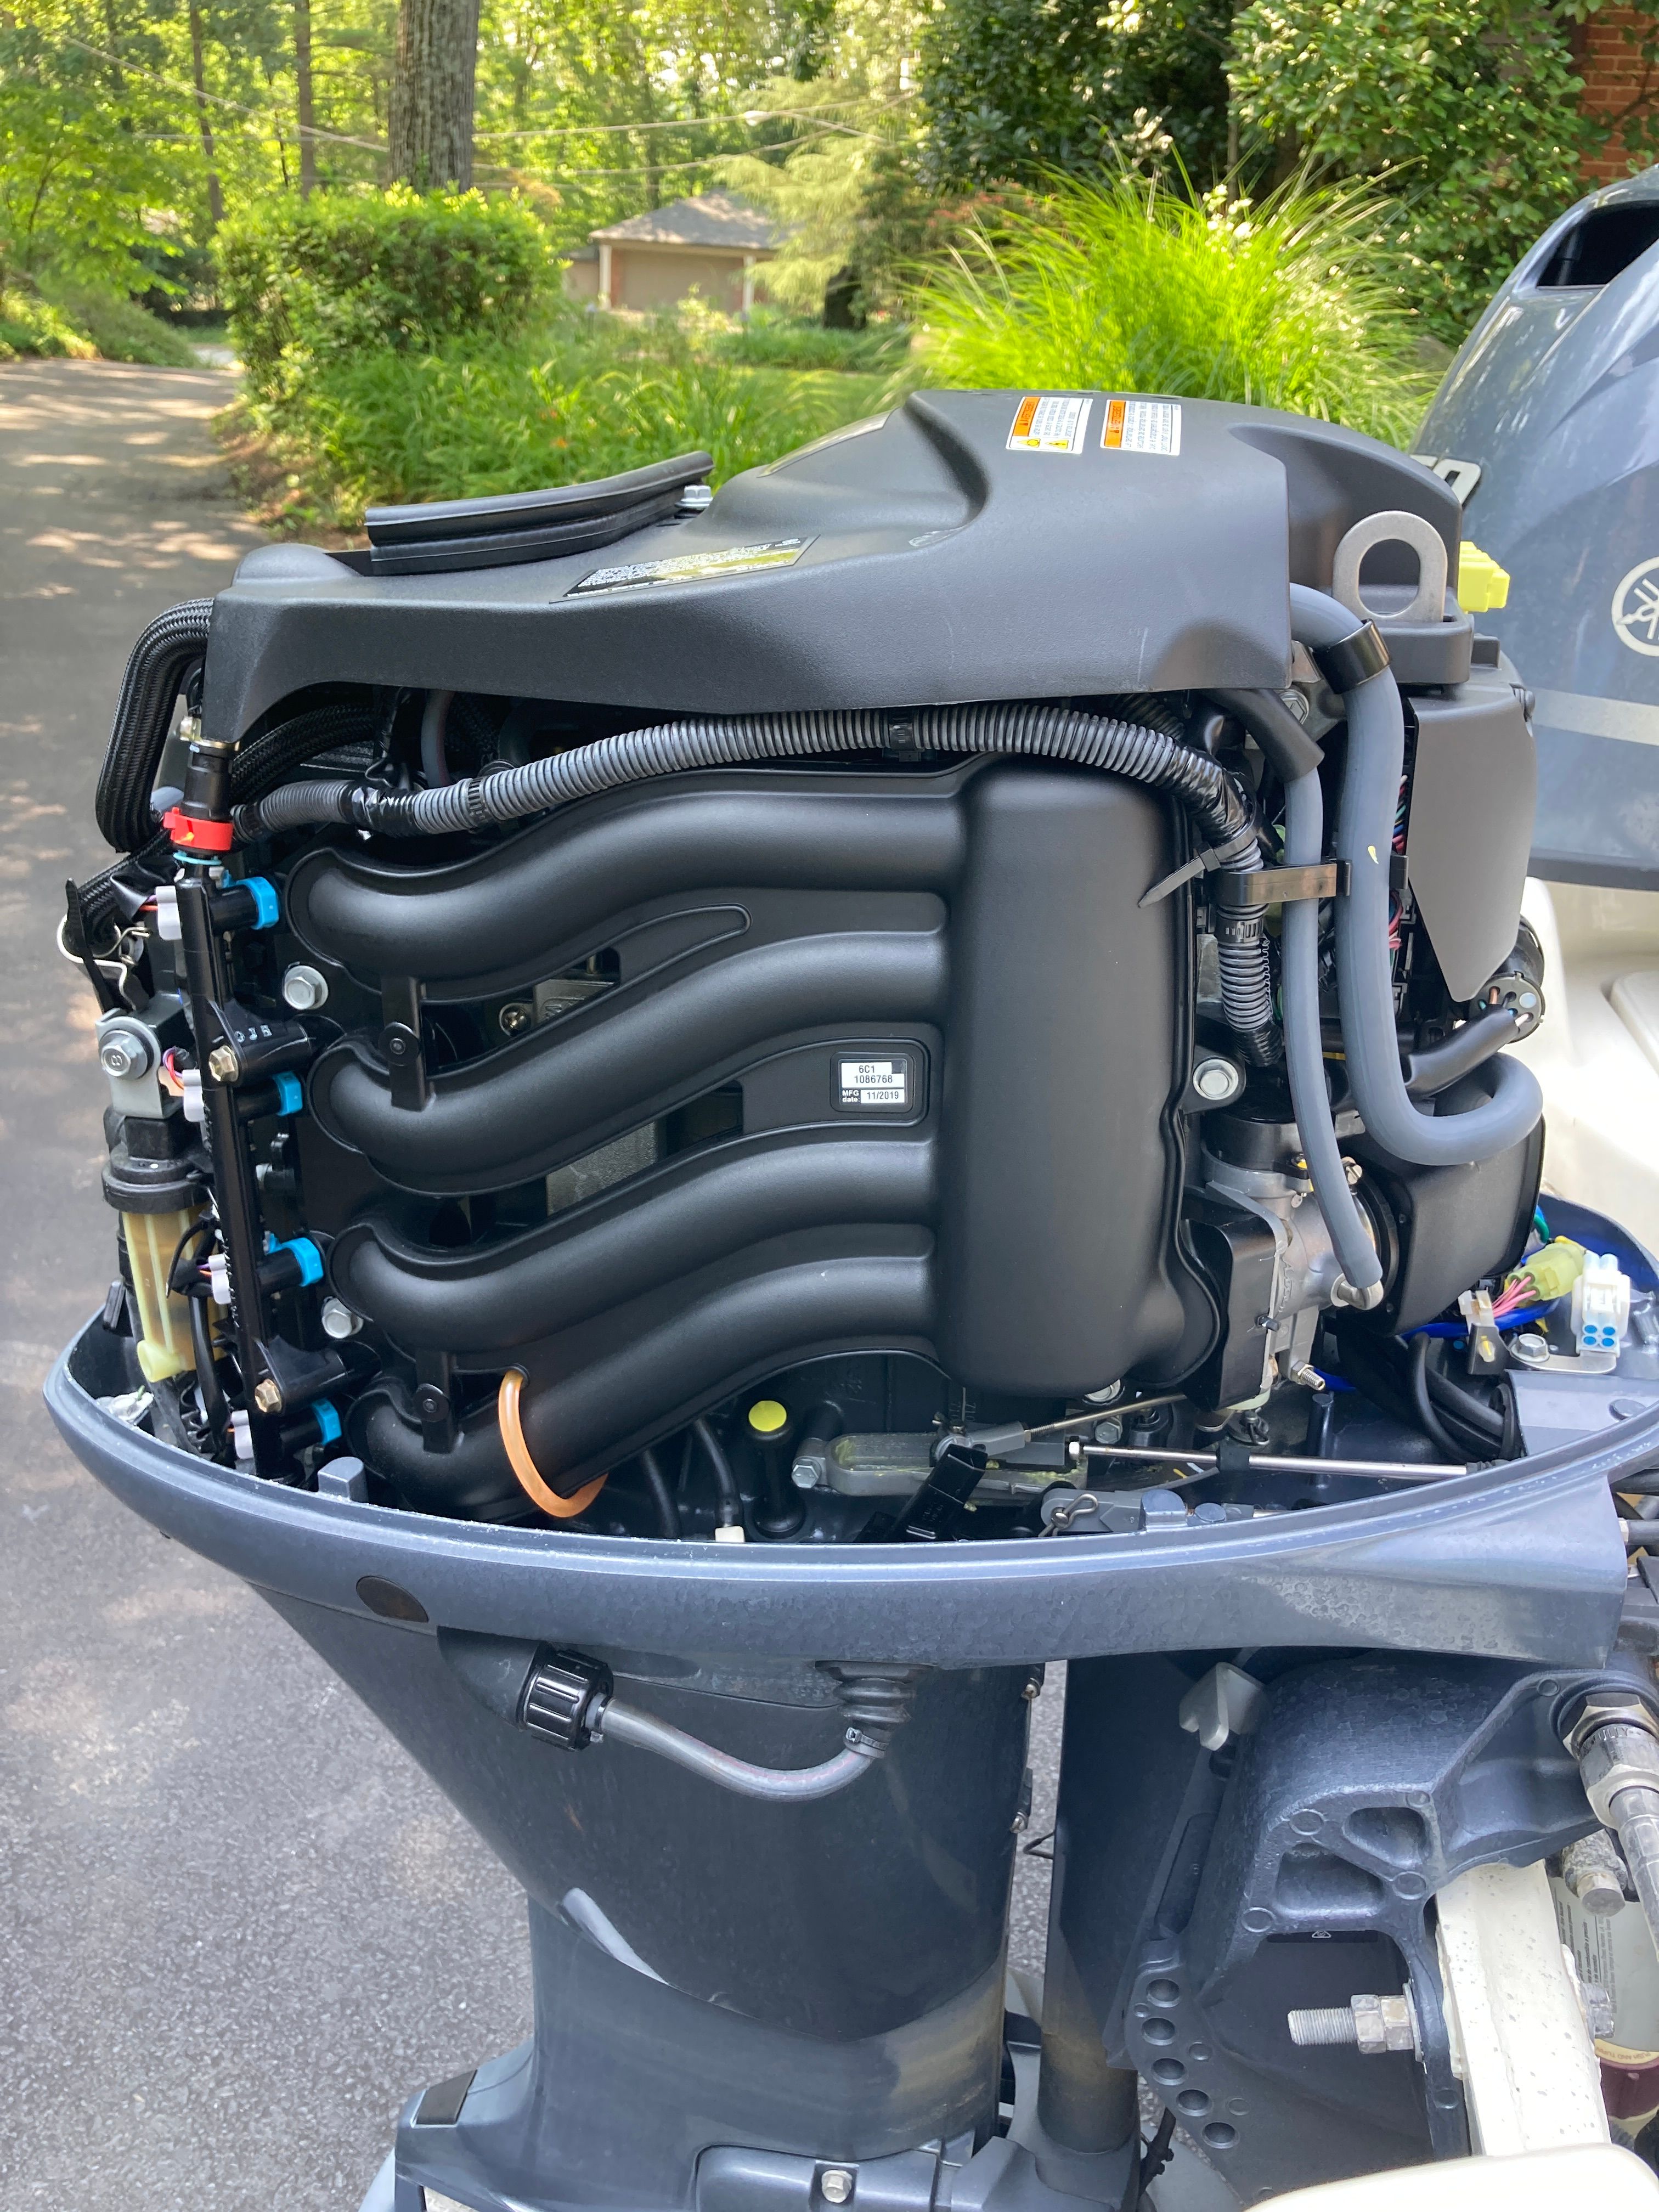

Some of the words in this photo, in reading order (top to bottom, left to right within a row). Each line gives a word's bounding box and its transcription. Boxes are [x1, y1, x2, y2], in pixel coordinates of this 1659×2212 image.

[859, 1065, 875, 1073] 6C1
[854, 1075, 893, 1084] 1086768
[867, 1091, 899, 1100] 11/2019
